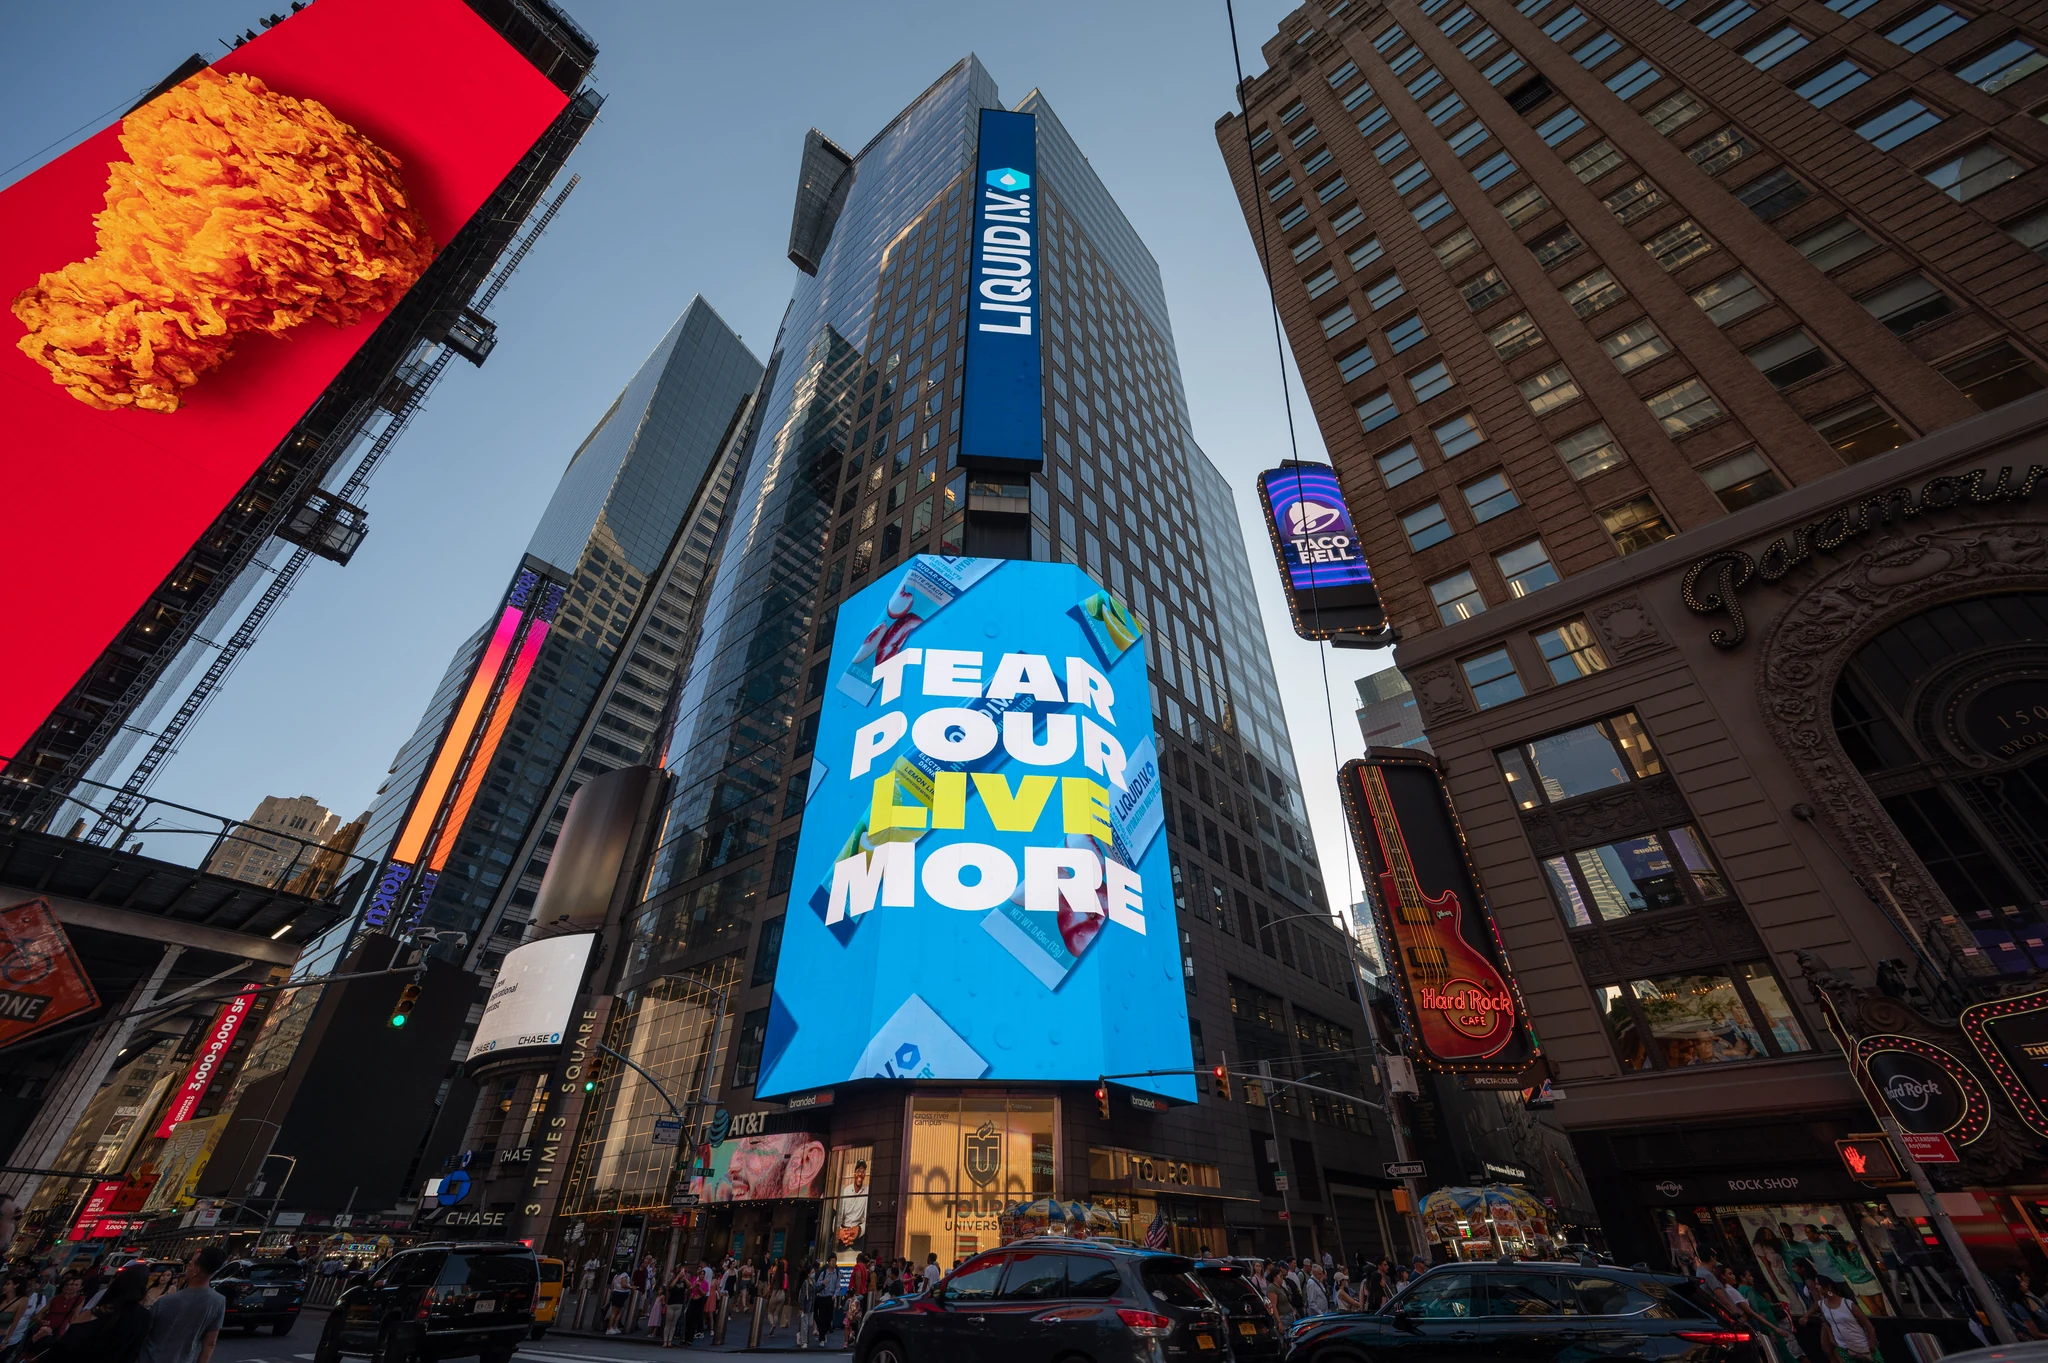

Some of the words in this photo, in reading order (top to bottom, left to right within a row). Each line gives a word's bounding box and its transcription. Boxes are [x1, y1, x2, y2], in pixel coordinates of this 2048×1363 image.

[980, 226, 1032, 336] LIQUID
[1290, 535, 1350, 552] TACO
[954, 555, 977, 573] HYDR
[1299, 548, 1356, 565] BELL
[916, 562, 954, 591] SUGAR-FREE
[928, 556, 963, 582] ELECTROLYTE
[924, 580, 944, 597] PEACH
[871, 647, 1118, 728] TEAR
[849, 708, 1127, 793] POUR
[918, 752, 945, 773] ELECTRO
[903, 766, 927, 787] LEMON
[868, 769, 1113, 847] LIVE
[1114, 782, 1144, 821] LIQUID
[825, 842, 1147, 937] MORE
[1009, 908, 1023, 923] NET
[1047, 941, 1065, 959] (13g)
[1420, 987, 1466, 1010] Hard
[1466, 988, 1514, 1016] Rock
[1460, 1015, 1487, 1027] CAFE
[188, 1014, 238, 1091] 3,000-9,000
[231, 997, 246, 1014] SF
[473, 1041, 491, 1055] CHASE
[518, 1034, 550, 1045] CHASE
[561, 1010, 598, 1093] SQUARE
[1474, 1077, 1519, 1085] SPECTACOLOR
[1884, 1085, 1904, 1100] Hard
[1904, 1080, 1942, 1098] Rock
[728, 1111, 769, 1137] AT&T
[914, 1119, 942, 1127] campus
[933, 1112, 950, 1120] river
[500, 1149, 533, 1163] CHAS
[533, 1116, 567, 1188] TIMES
[1132, 1156, 1189, 1185] TOURO
[1728, 1178, 1764, 1191] ROCK
[1763, 1177, 1799, 1190] SHOP
[445, 1212, 505, 1225] CHASE
[525, 1203, 542, 1217] 3
[945, 1220, 1000, 1231] UNIVERS
